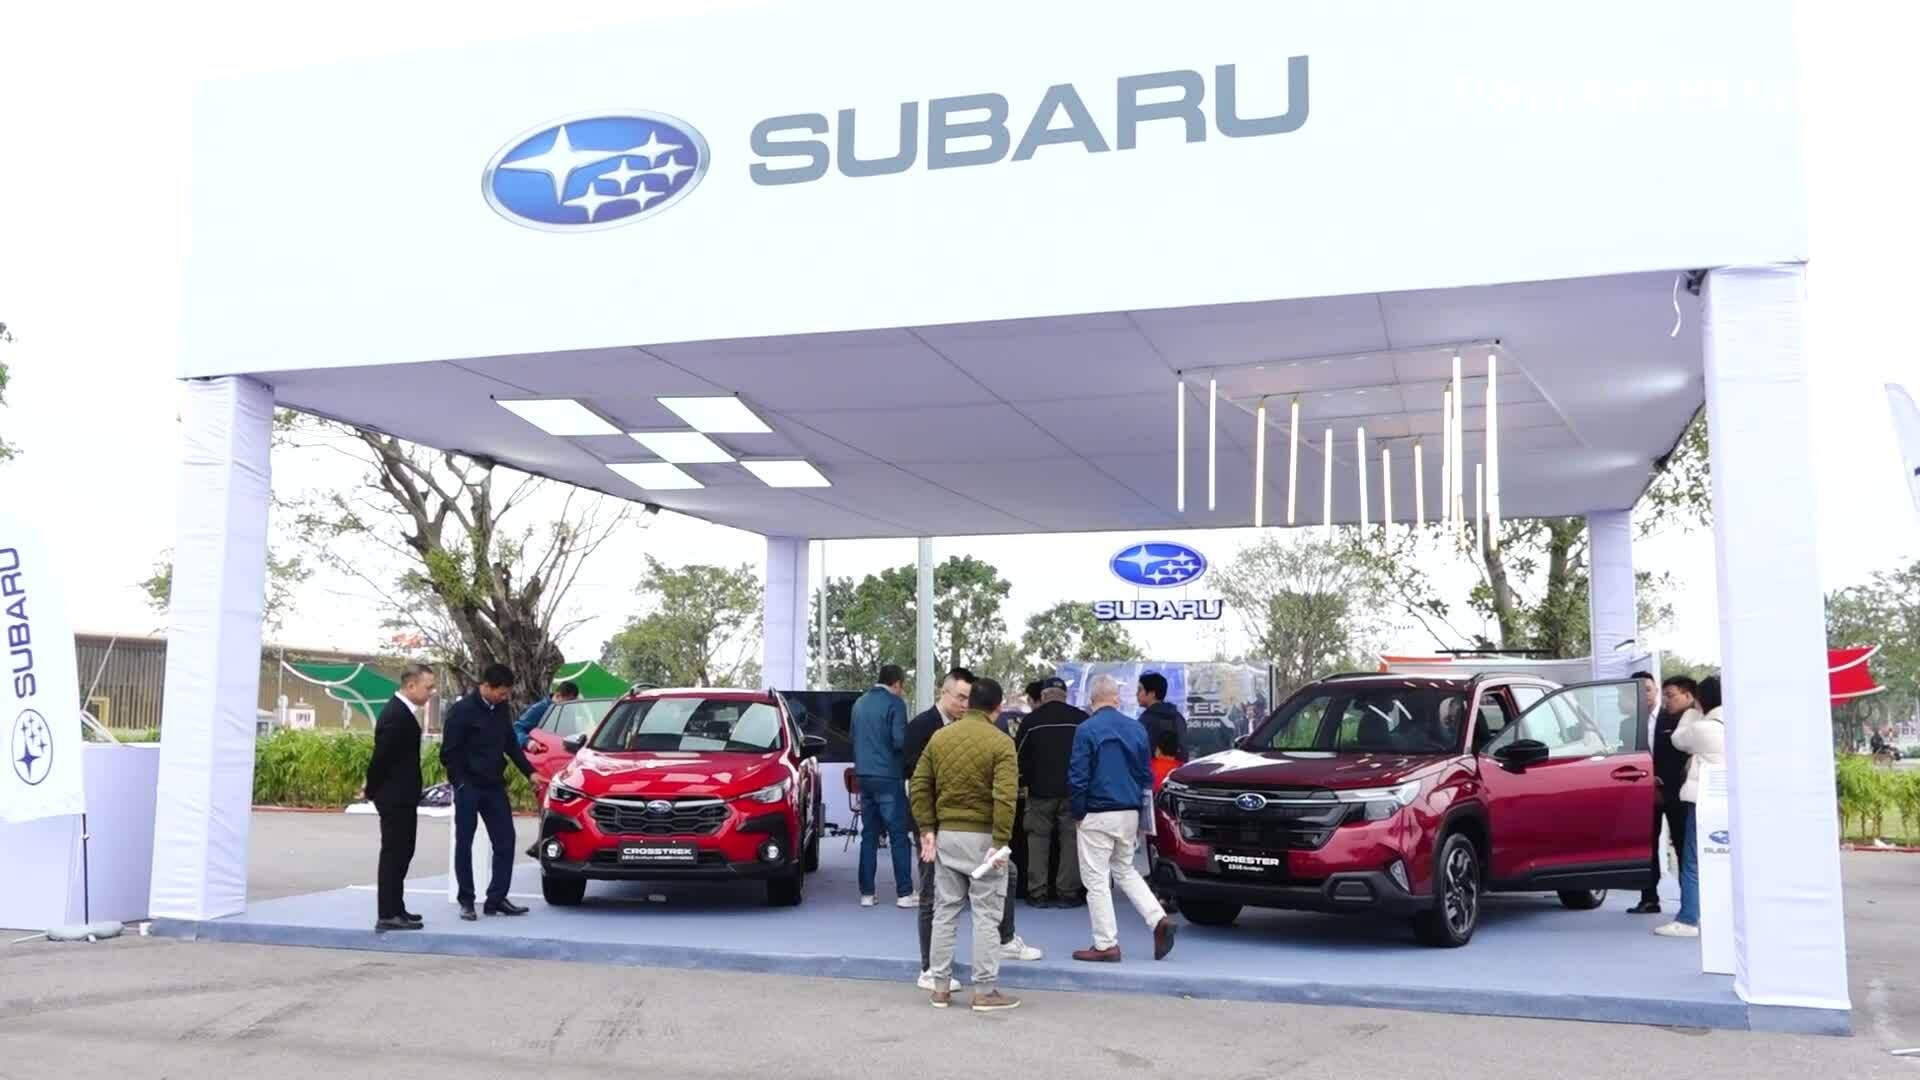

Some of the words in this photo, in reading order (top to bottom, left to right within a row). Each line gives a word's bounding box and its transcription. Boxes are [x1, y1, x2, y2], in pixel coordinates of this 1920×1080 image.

[748, 54, 1310, 186] SUBARU
[1094, 599, 1223, 621] SUBARU
[0, 547, 37, 699] SUBARU
[623, 847, 692, 855] CROSSTREK
[1213, 854, 1280, 866] FORESTER
